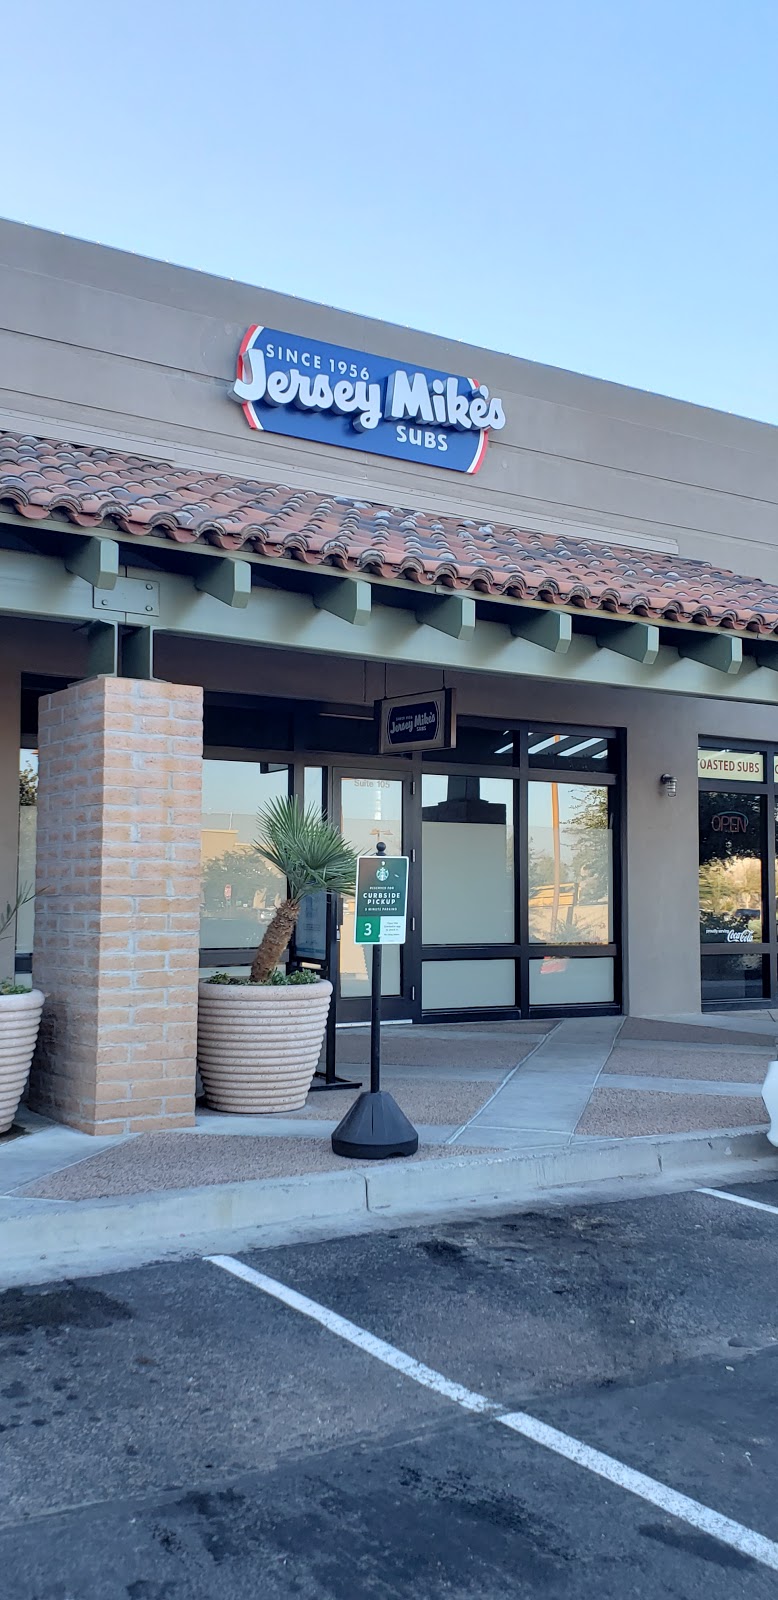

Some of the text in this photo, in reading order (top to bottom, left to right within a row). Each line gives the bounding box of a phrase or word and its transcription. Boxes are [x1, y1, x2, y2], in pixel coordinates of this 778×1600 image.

[266, 343, 370, 381] SINCE 1956
[232, 348, 506, 430] Jersey Mike's
[396, 425, 448, 451] SUBS
[390, 720, 413, 734] Jersey
[698, 758, 735, 771] OASTED
[737, 761, 760, 773] SUBS
[354, 779, 390, 788] Suite 105
[711, 815, 747, 833] OPEN
[363, 922, 372, 936] 3
